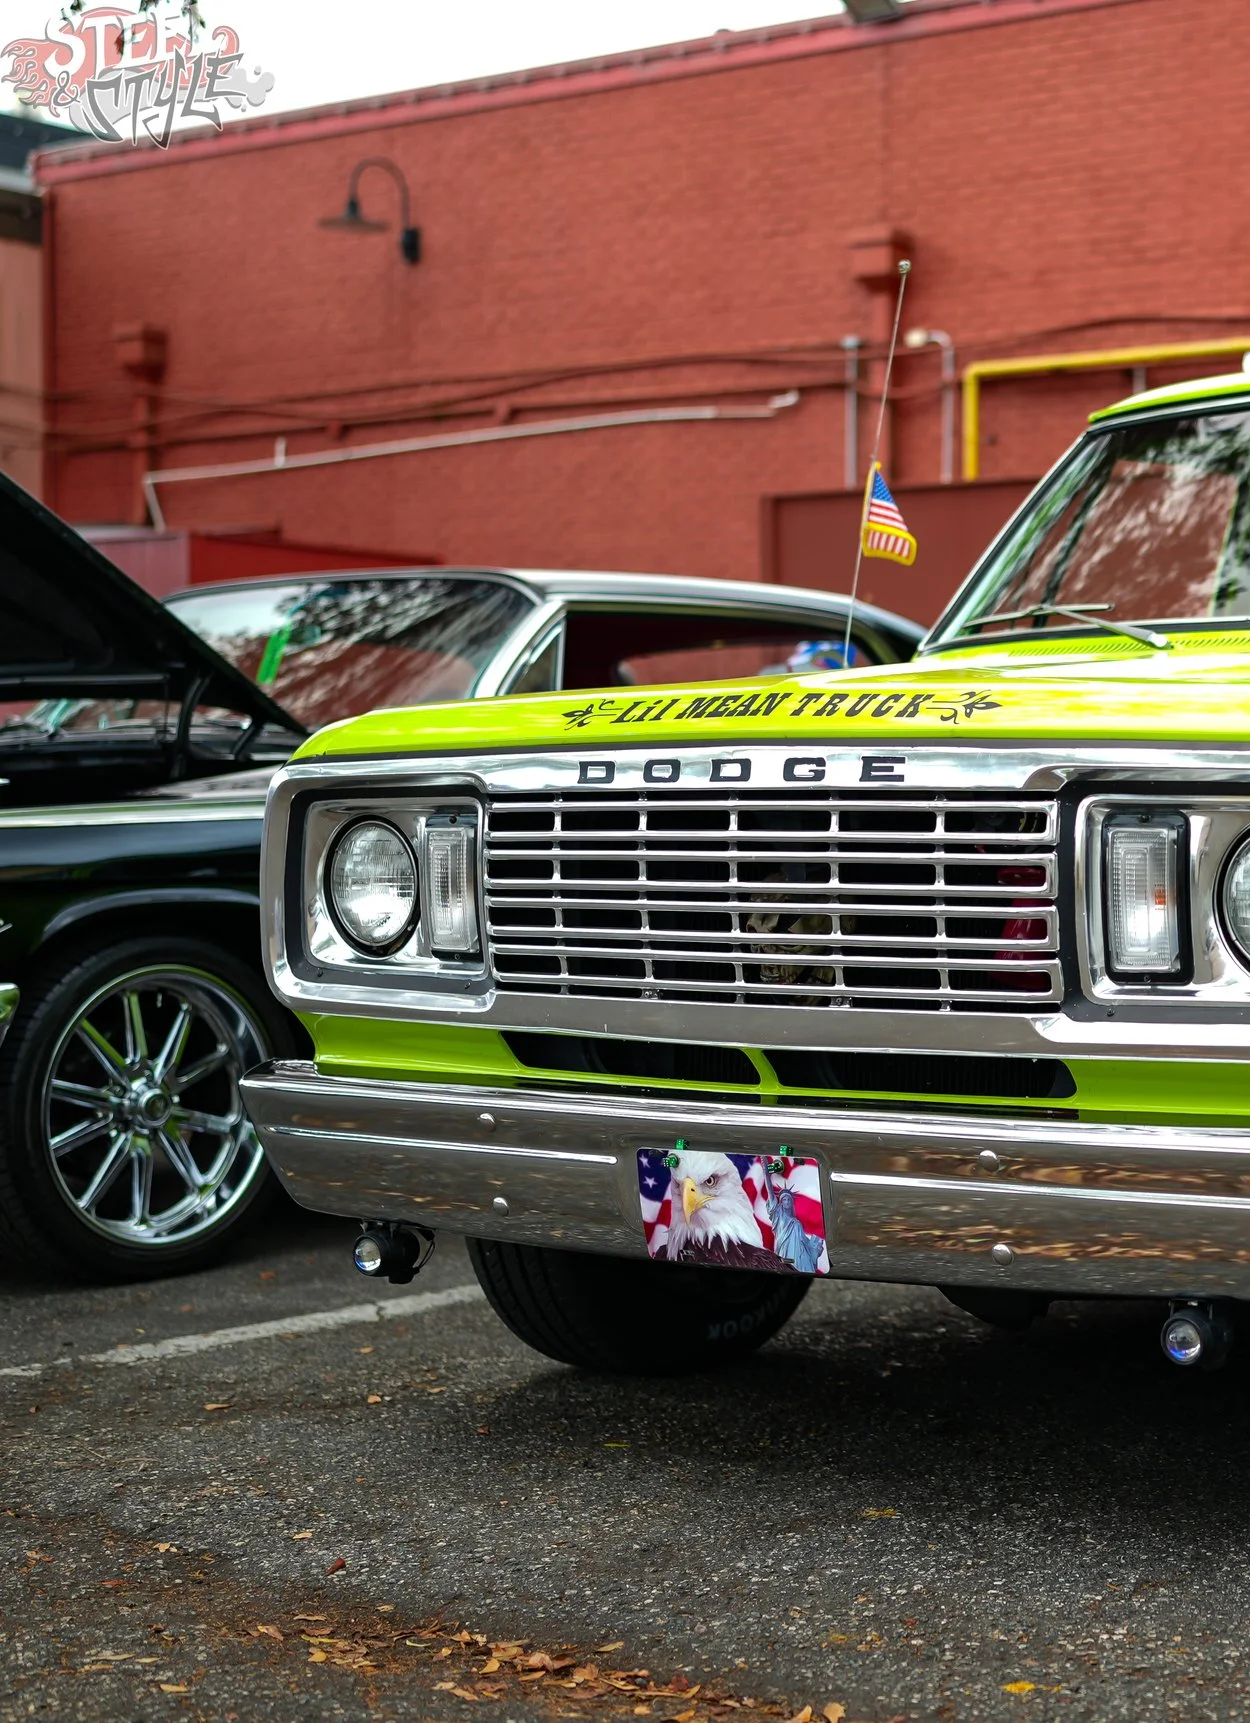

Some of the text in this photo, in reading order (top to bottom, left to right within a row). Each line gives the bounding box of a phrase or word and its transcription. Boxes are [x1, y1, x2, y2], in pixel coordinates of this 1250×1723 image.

[674, 692, 793, 720] MEAN
[789, 692, 935, 719] TRUCK
[577, 756, 906, 785] DODGE
